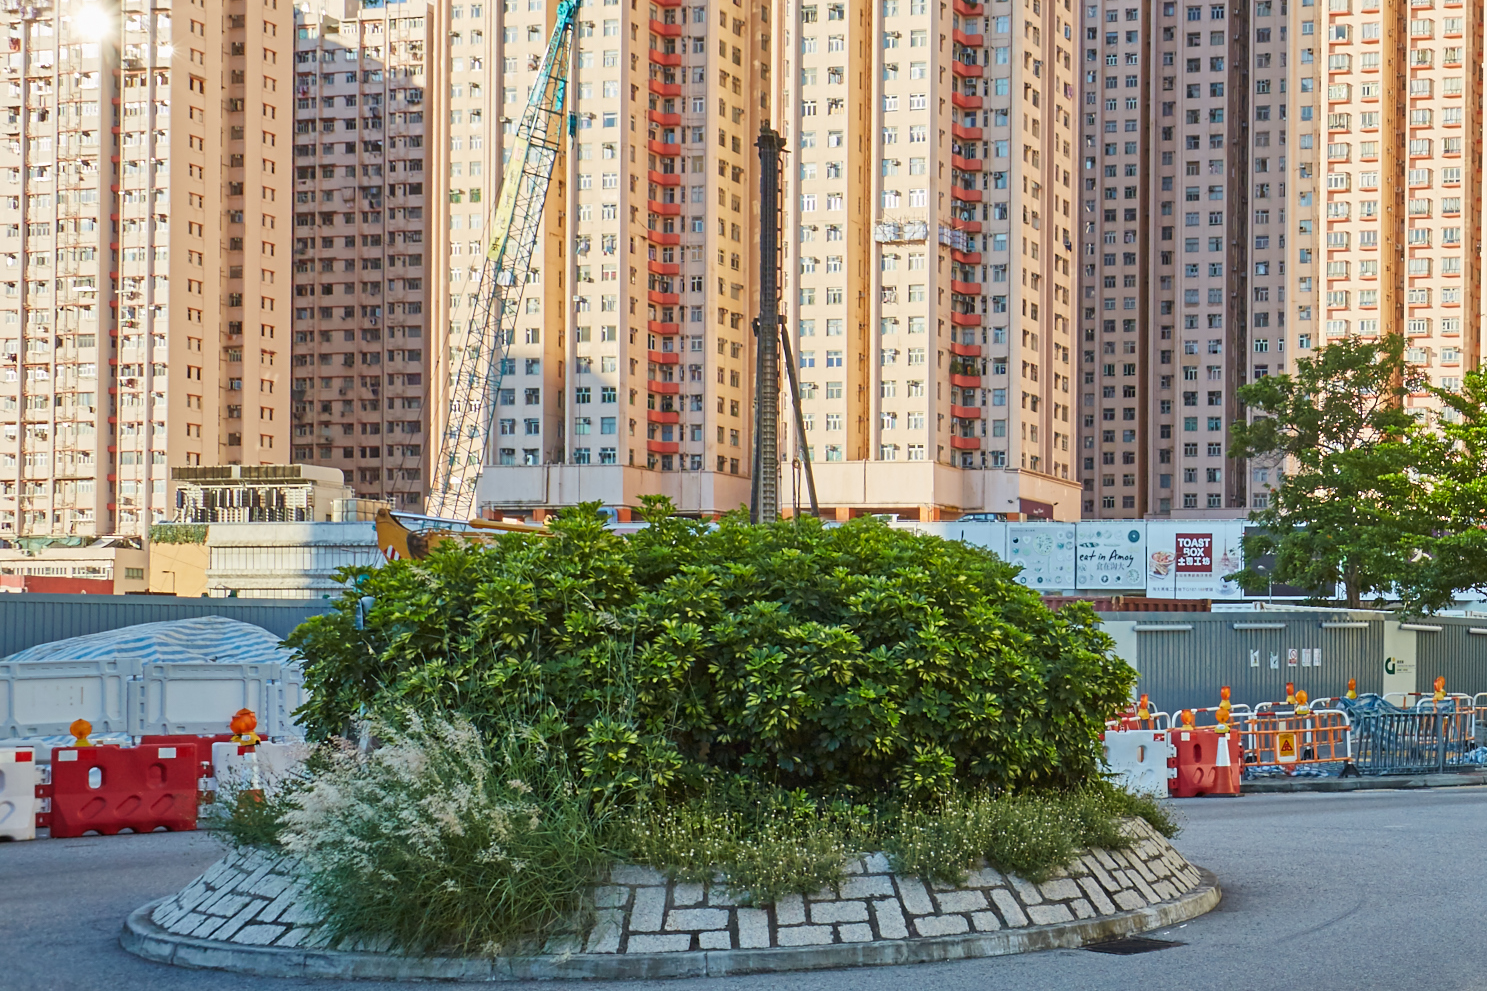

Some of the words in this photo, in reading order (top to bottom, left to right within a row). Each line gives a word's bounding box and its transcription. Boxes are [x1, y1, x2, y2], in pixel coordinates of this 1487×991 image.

[1177, 538, 1211, 548] TOAST
[1183, 547, 1205, 557] BOX
[1079, 549, 1096, 561] eat
[1098, 553, 1106, 561] in
[1108, 549, 1134, 568] Amoy
